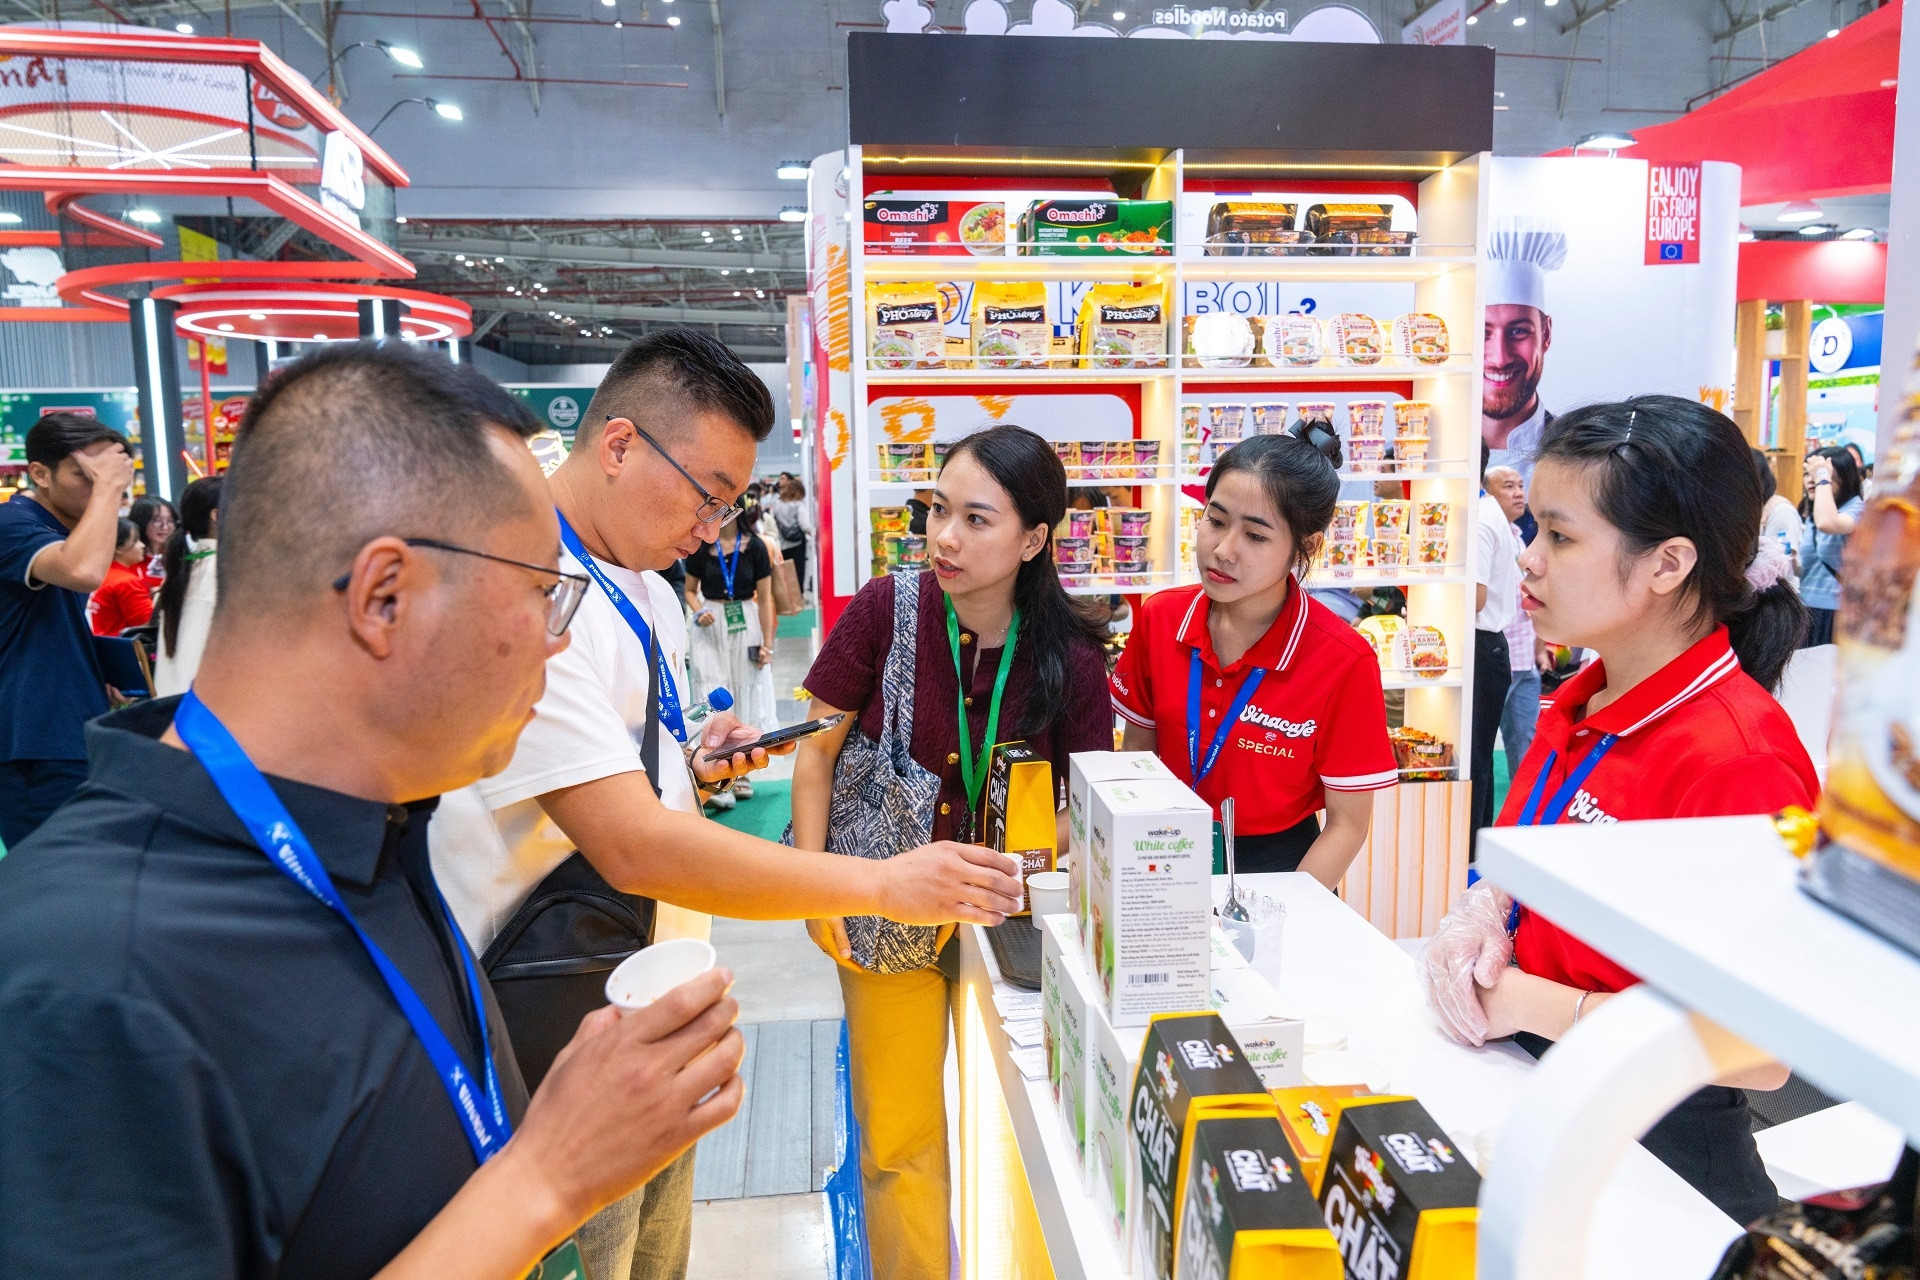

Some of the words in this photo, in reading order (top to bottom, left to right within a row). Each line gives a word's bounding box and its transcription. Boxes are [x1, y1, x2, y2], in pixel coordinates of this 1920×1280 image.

[1650, 166, 1698, 197] ENJOY
[877, 207, 929, 222] Omachi
[1046, 207, 1098, 222] Omachi
[1649, 196, 1668, 217] IT'S
[1669, 197, 1697, 217] FROM
[1648, 216, 1696, 241] EUROPE
[1239, 703, 1318, 738] Vinacafé
[1237, 737, 1295, 759] SPECIAL
[1147, 826, 1181, 837] wake-up
[1133, 840, 1165, 852] White
[1167, 837, 1194, 853] coffee
[1262, 1047, 1288, 1063] coffee
